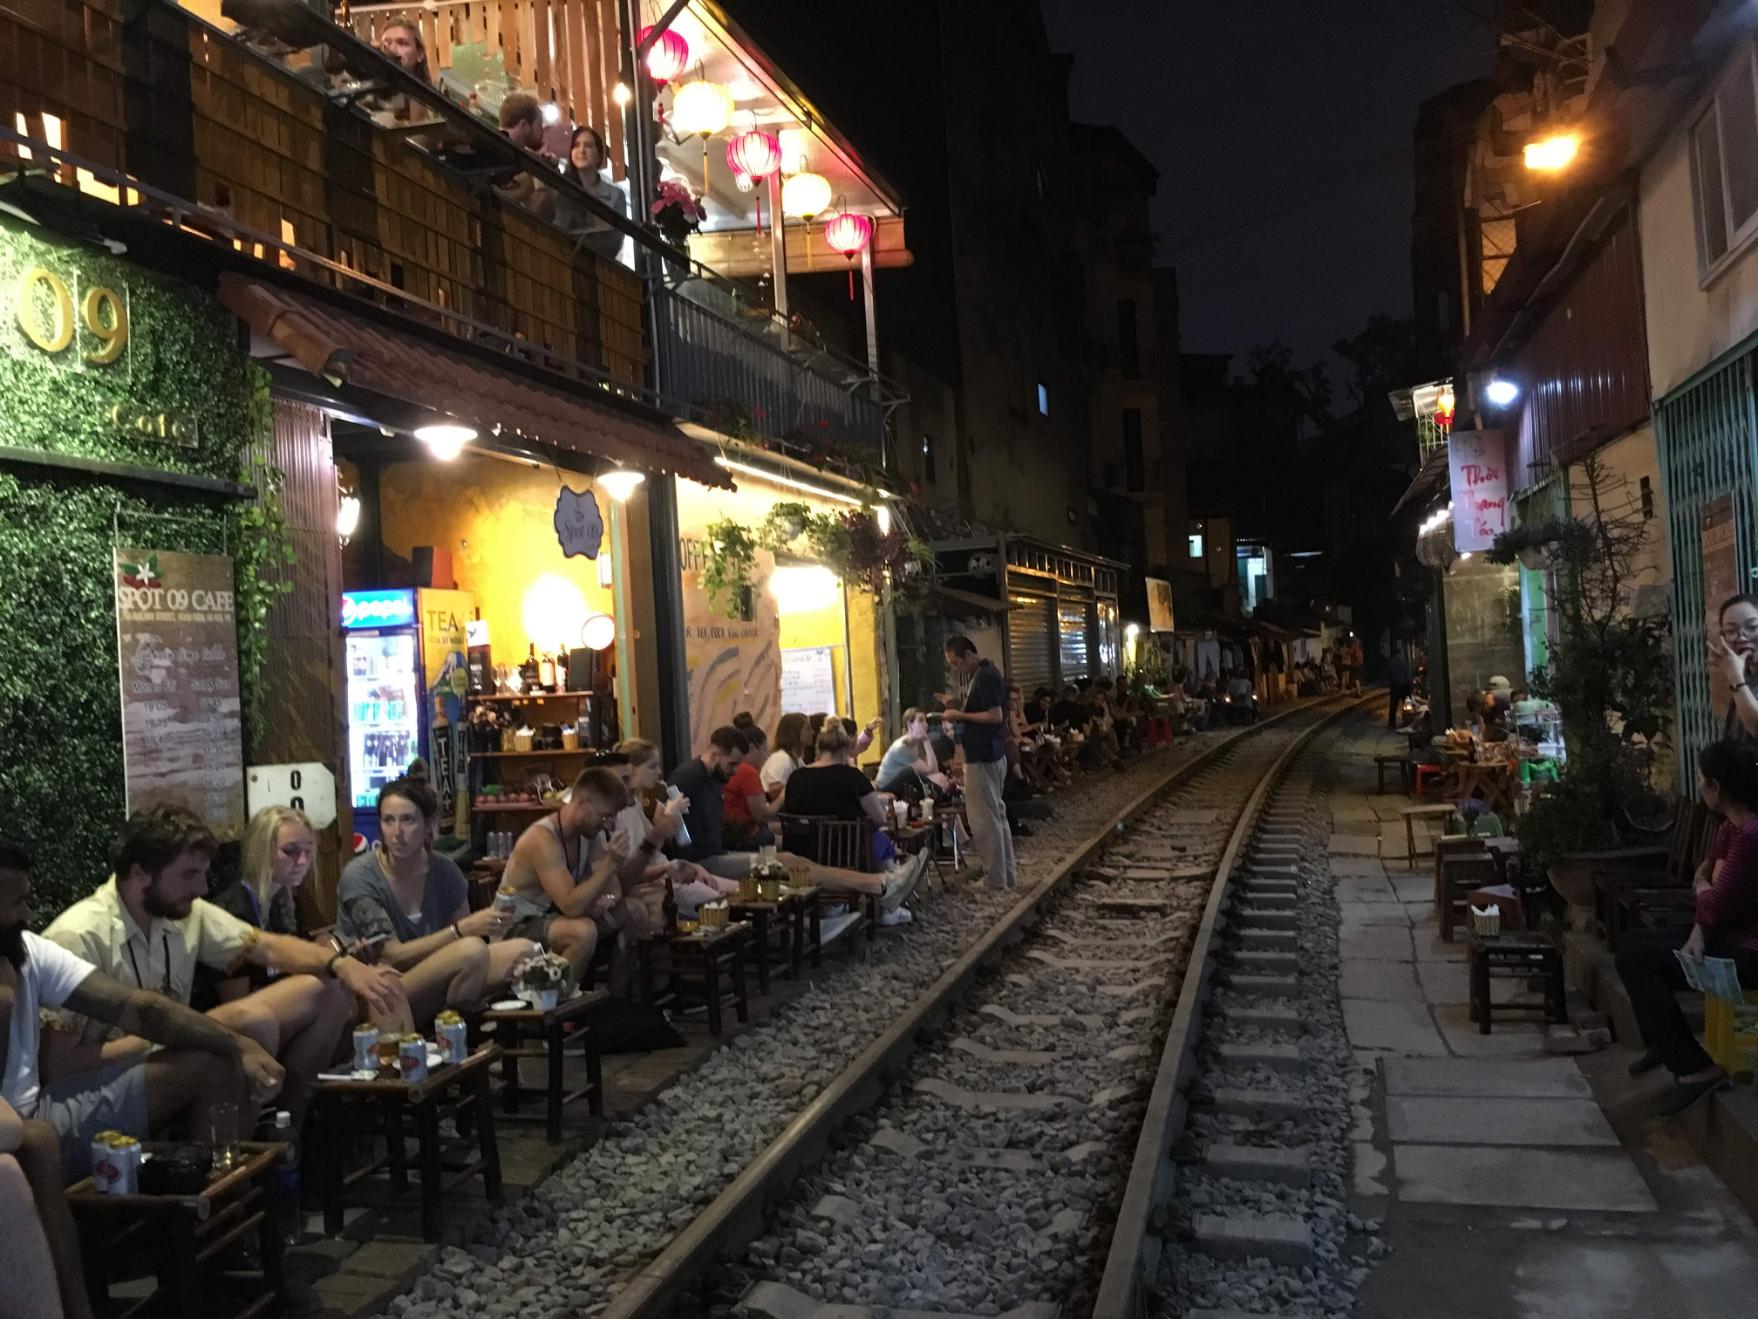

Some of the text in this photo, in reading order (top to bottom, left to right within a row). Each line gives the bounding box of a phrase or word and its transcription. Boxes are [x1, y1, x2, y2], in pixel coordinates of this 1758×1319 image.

[17, 267, 129, 364] 09
[119, 587, 164, 610] SPOT
[167, 589, 189, 610] 09
